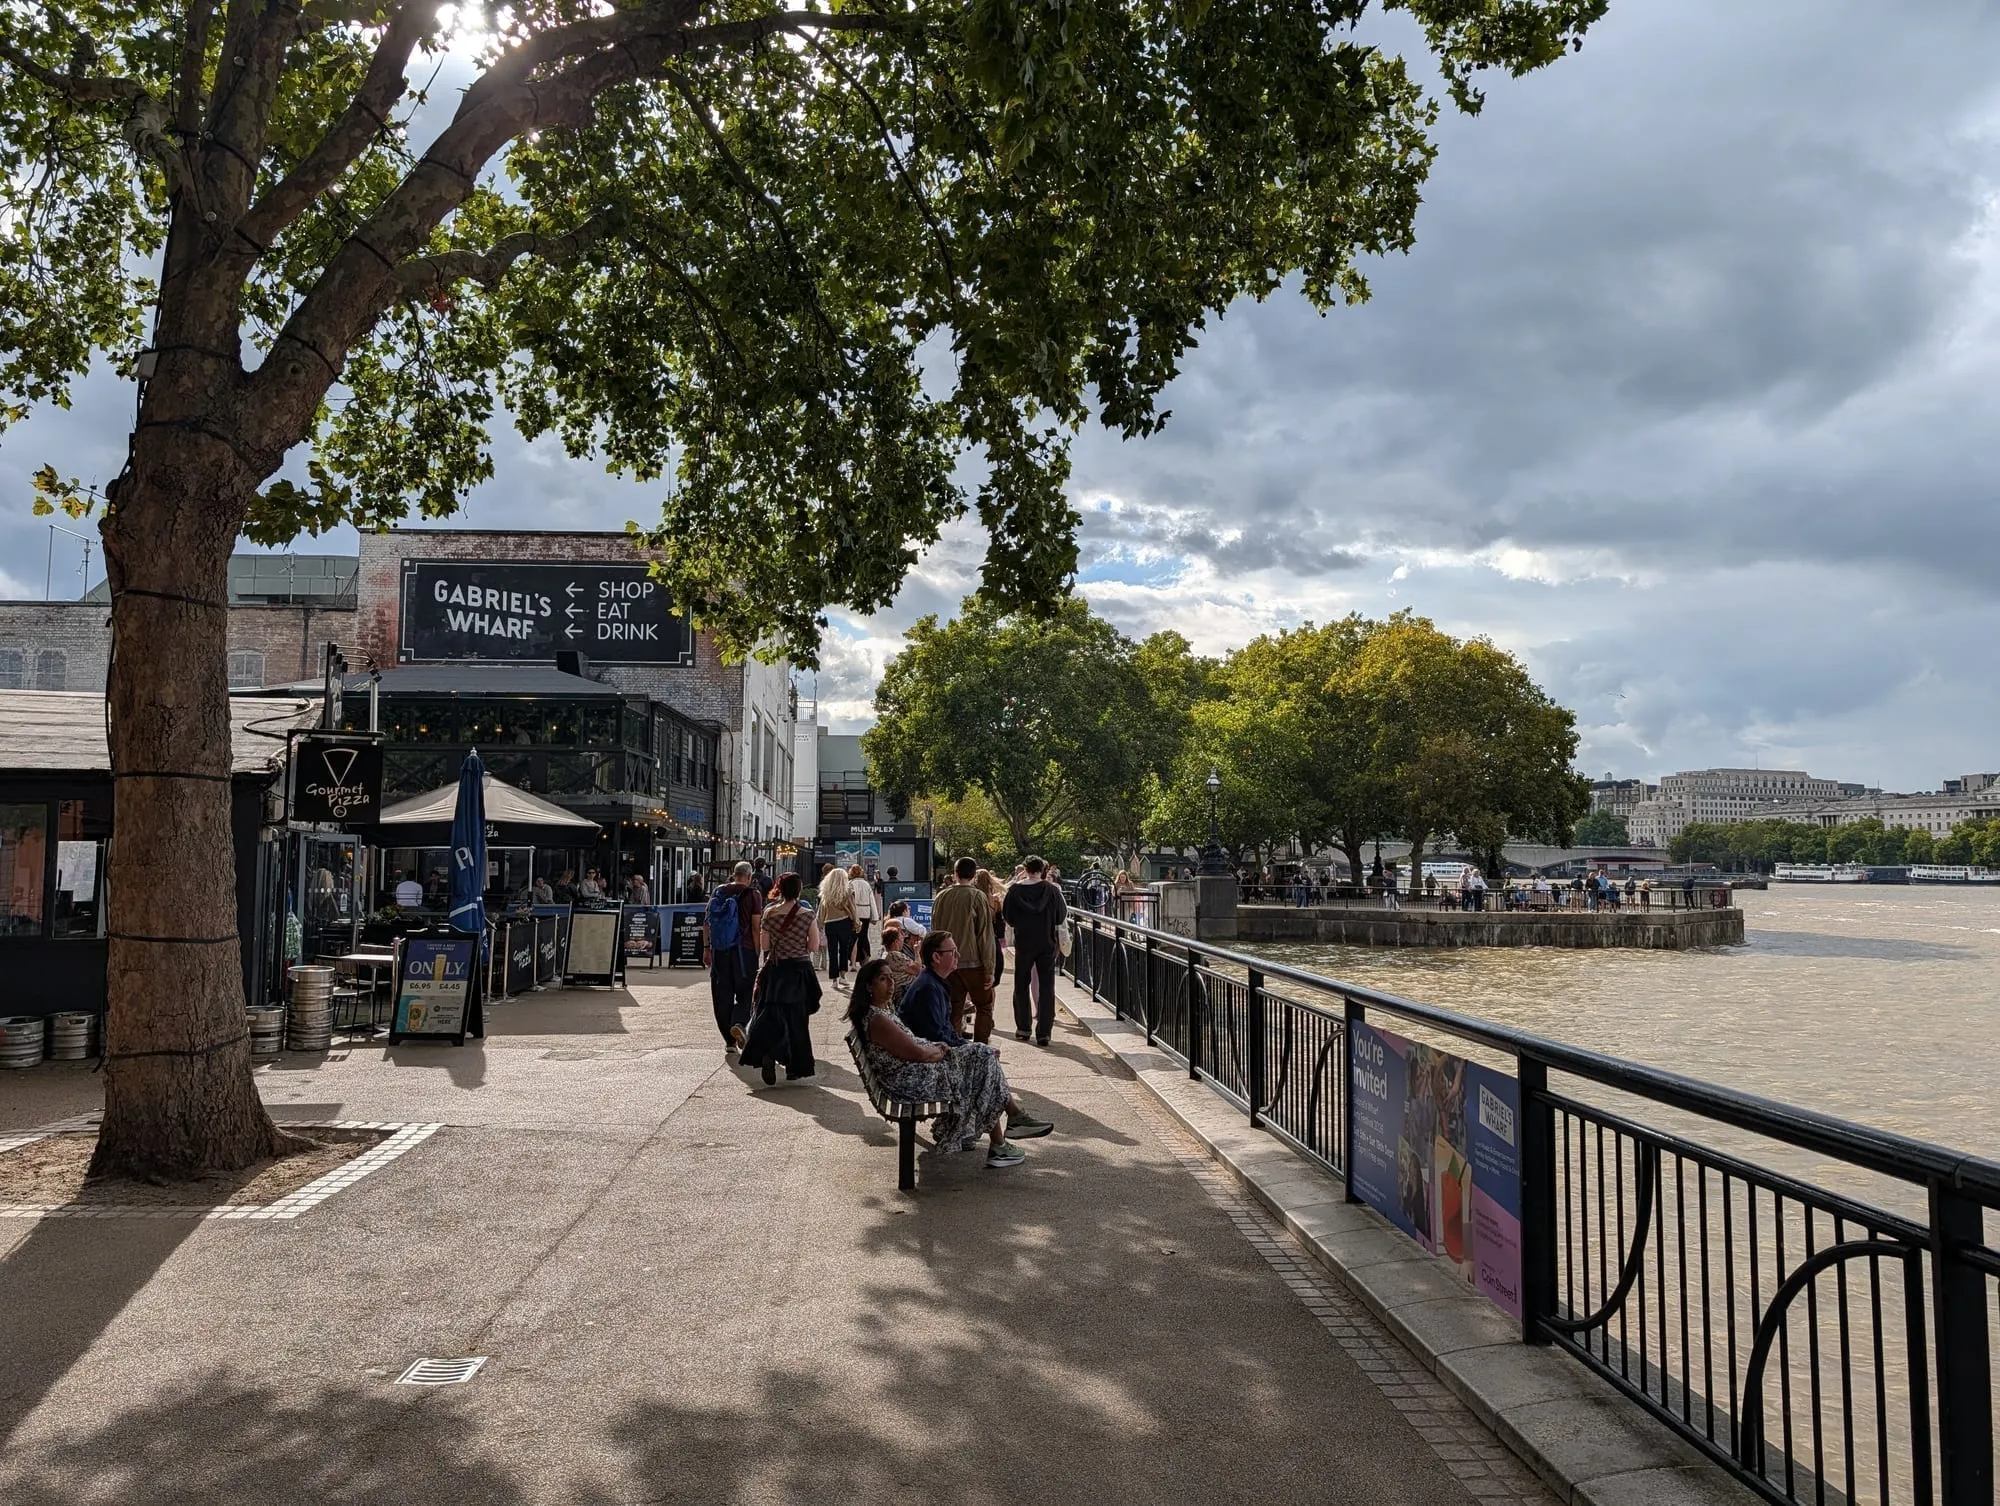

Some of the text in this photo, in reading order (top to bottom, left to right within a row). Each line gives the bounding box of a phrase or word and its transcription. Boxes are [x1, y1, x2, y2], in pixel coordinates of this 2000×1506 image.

[433, 580, 552, 617] GABRIEL'S
[598, 581, 655, 599] SHOP
[446, 608, 535, 640] WHARF
[597, 602, 631, 620] EAT
[597, 623, 659, 641] DRINK
[305, 782, 364, 796] Gourmet
[328, 792, 370, 807] Pizza
[1352, 1028, 1384, 1067] You're
[1353, 1058, 1388, 1101] invited
[1481, 1090, 1513, 1126] GABRIEL'S
[1484, 1107, 1508, 1137] WHARF
